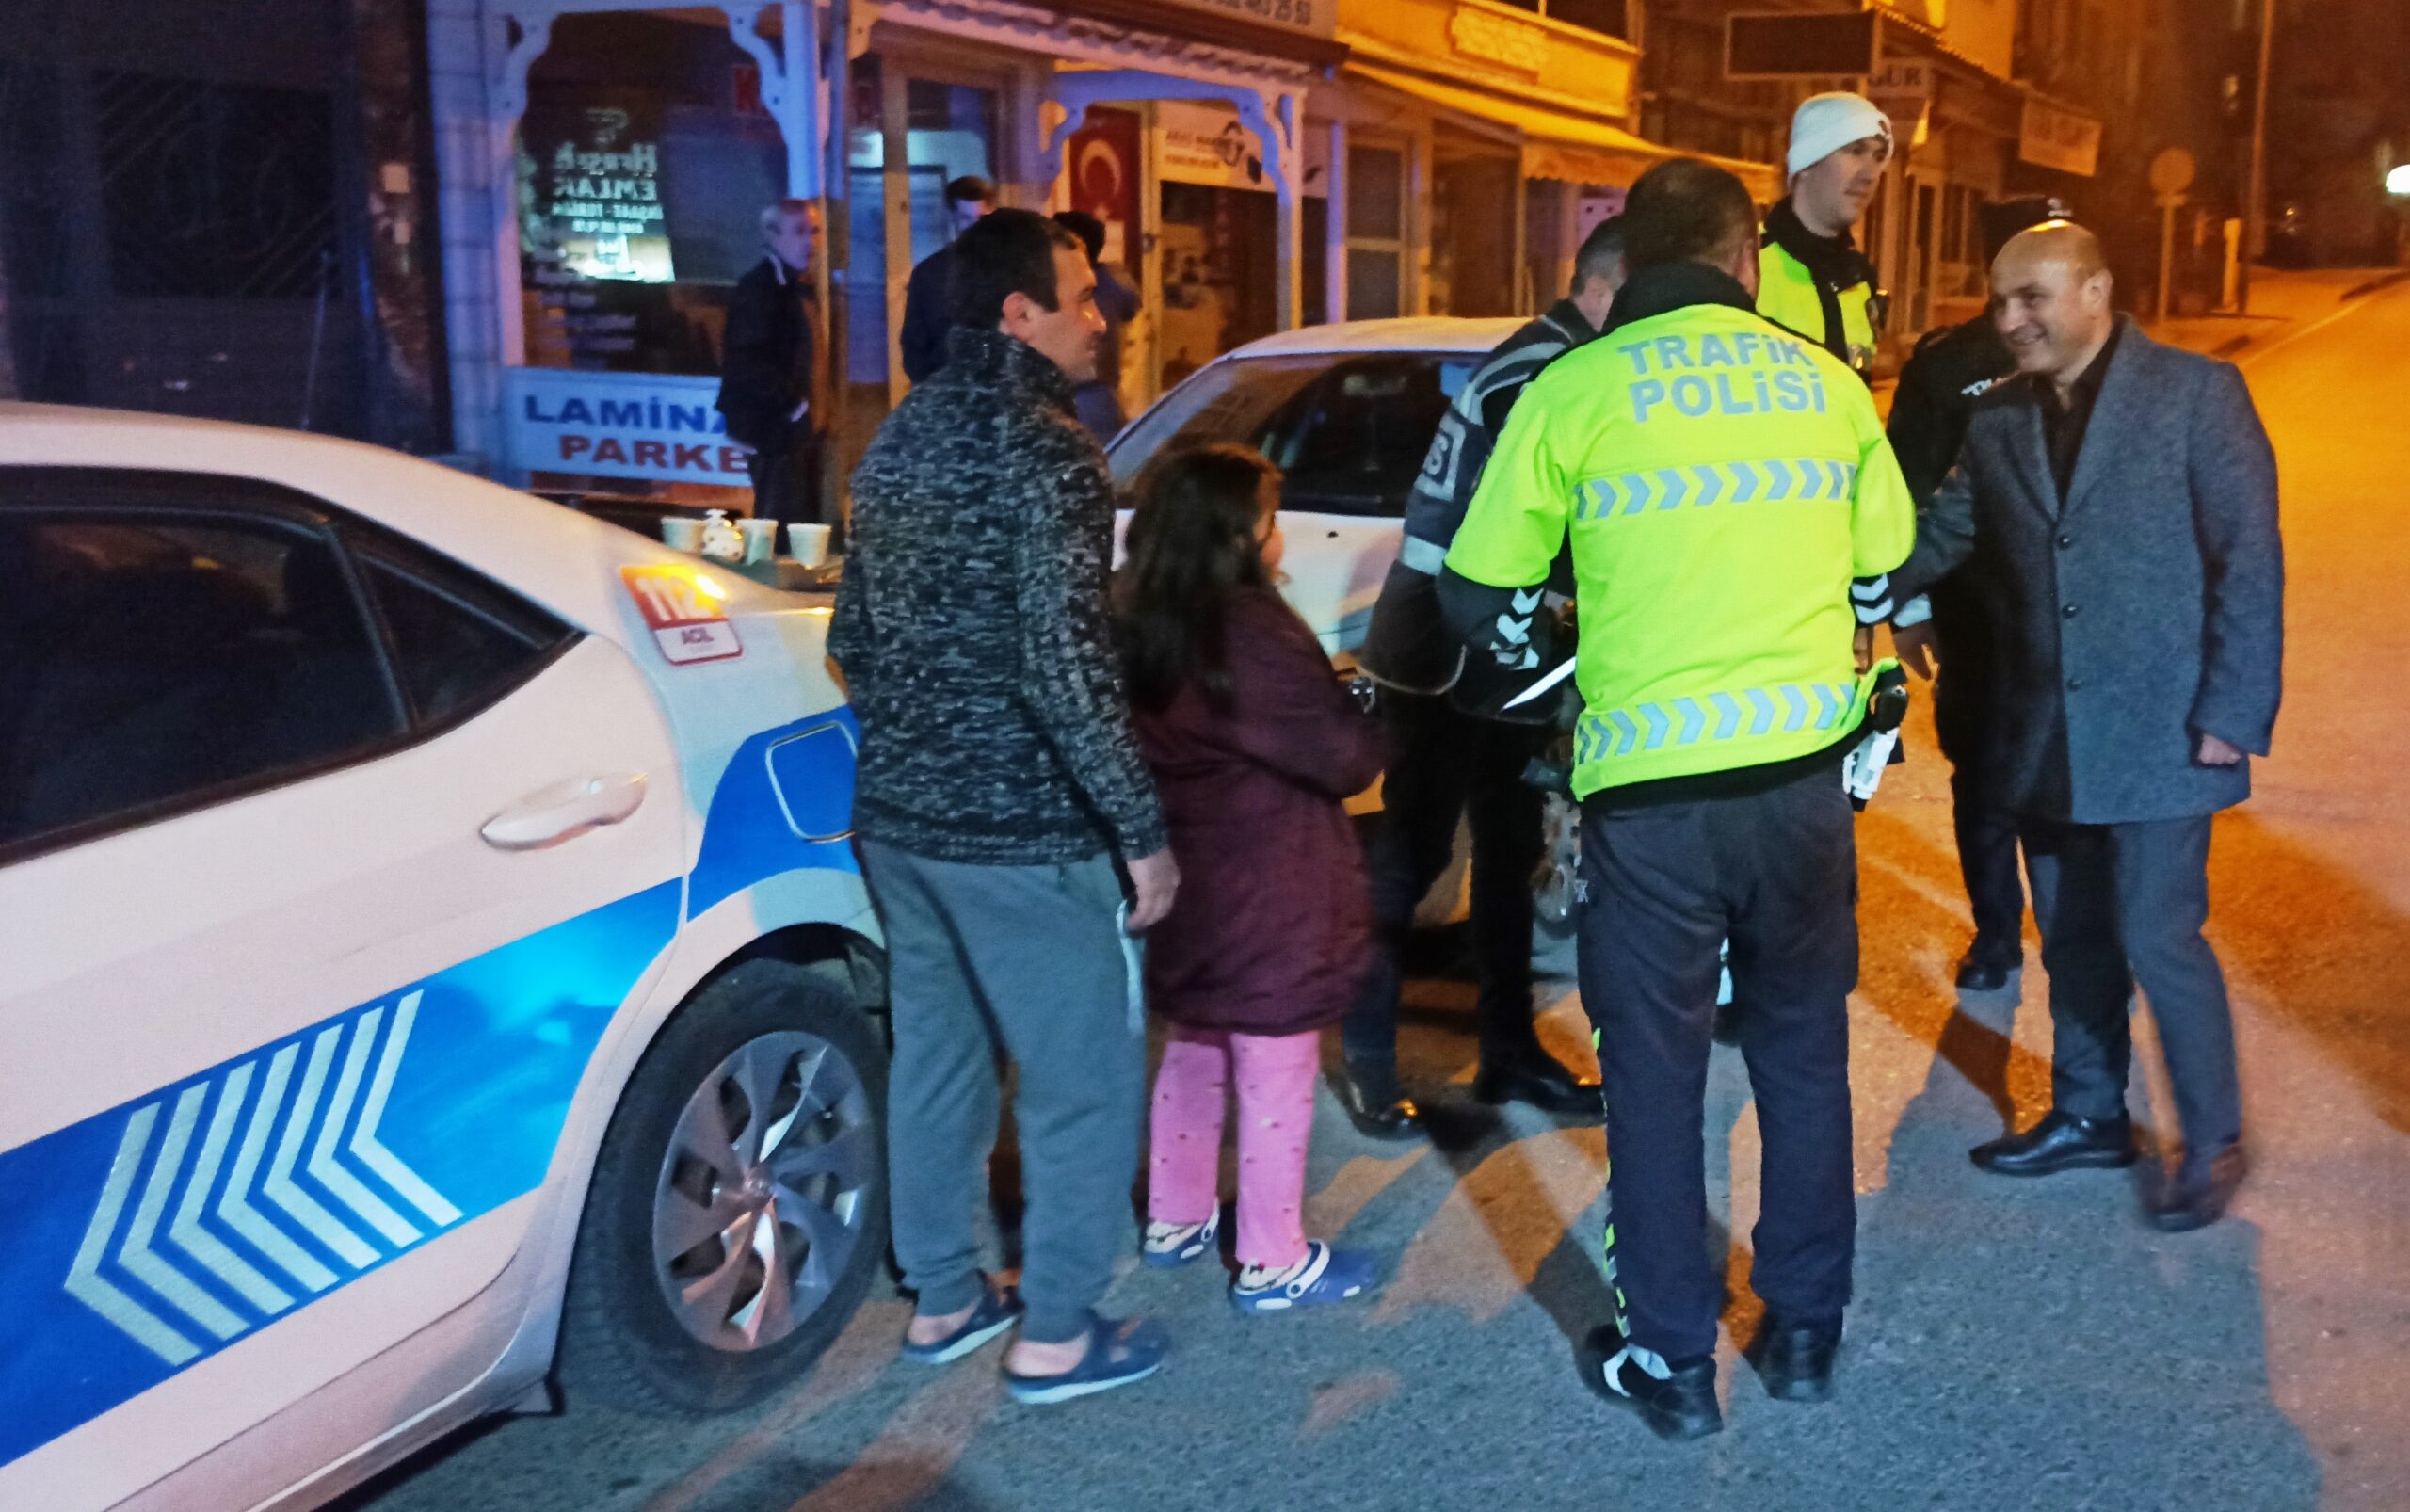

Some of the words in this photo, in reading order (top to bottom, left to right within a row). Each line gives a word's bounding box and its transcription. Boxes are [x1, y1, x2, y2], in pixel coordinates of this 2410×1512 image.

[1616, 332, 1814, 375] TRAFİK
[1629, 370, 1825, 423] POLİSİ
[559, 434, 750, 475] PARKE
